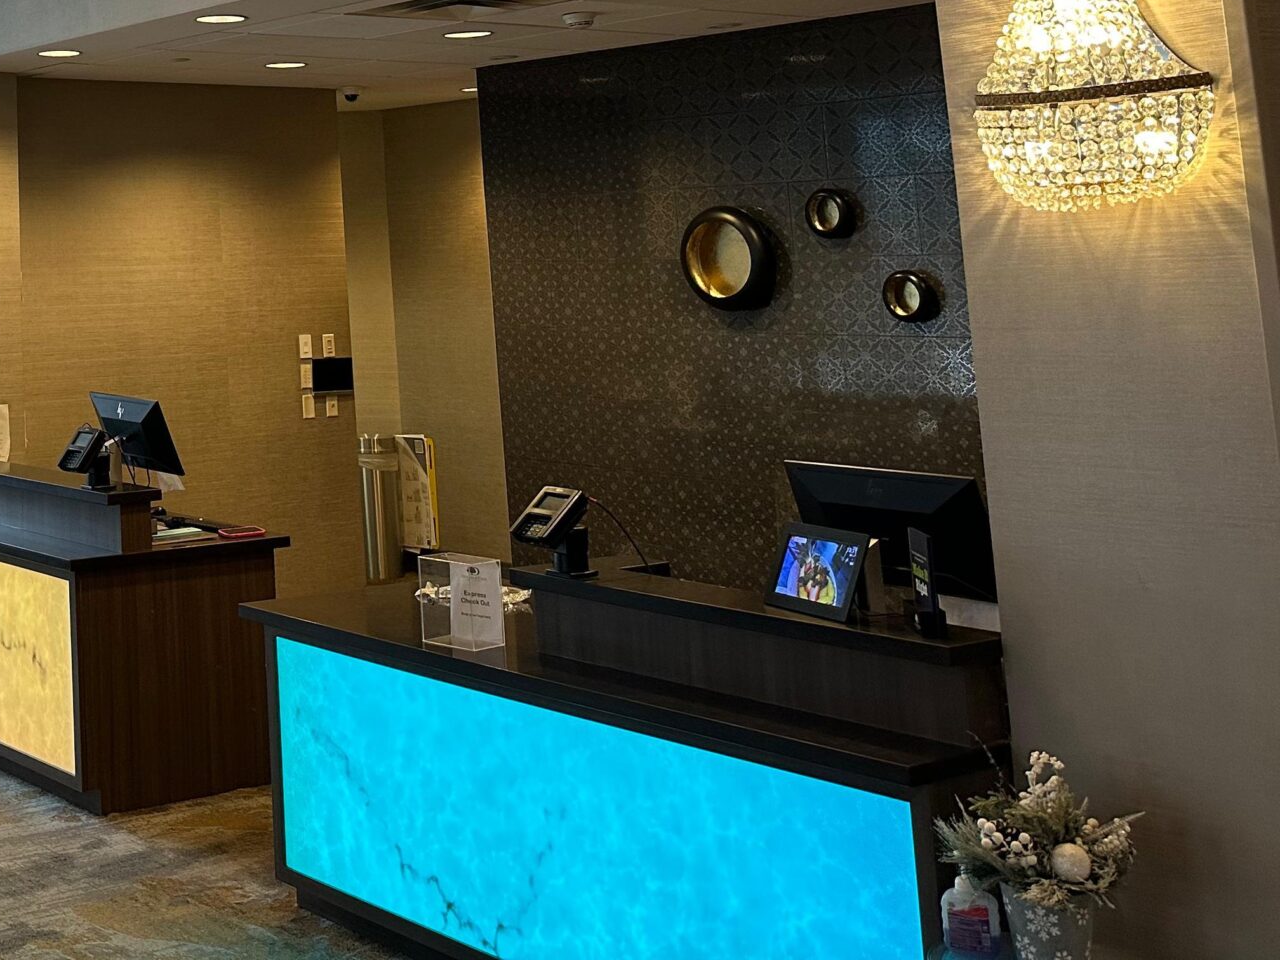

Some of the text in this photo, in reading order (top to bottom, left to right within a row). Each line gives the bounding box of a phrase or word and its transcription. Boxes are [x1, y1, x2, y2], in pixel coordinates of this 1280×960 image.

[463, 589, 487, 599] Express
[460, 597, 490, 607] Check Out
